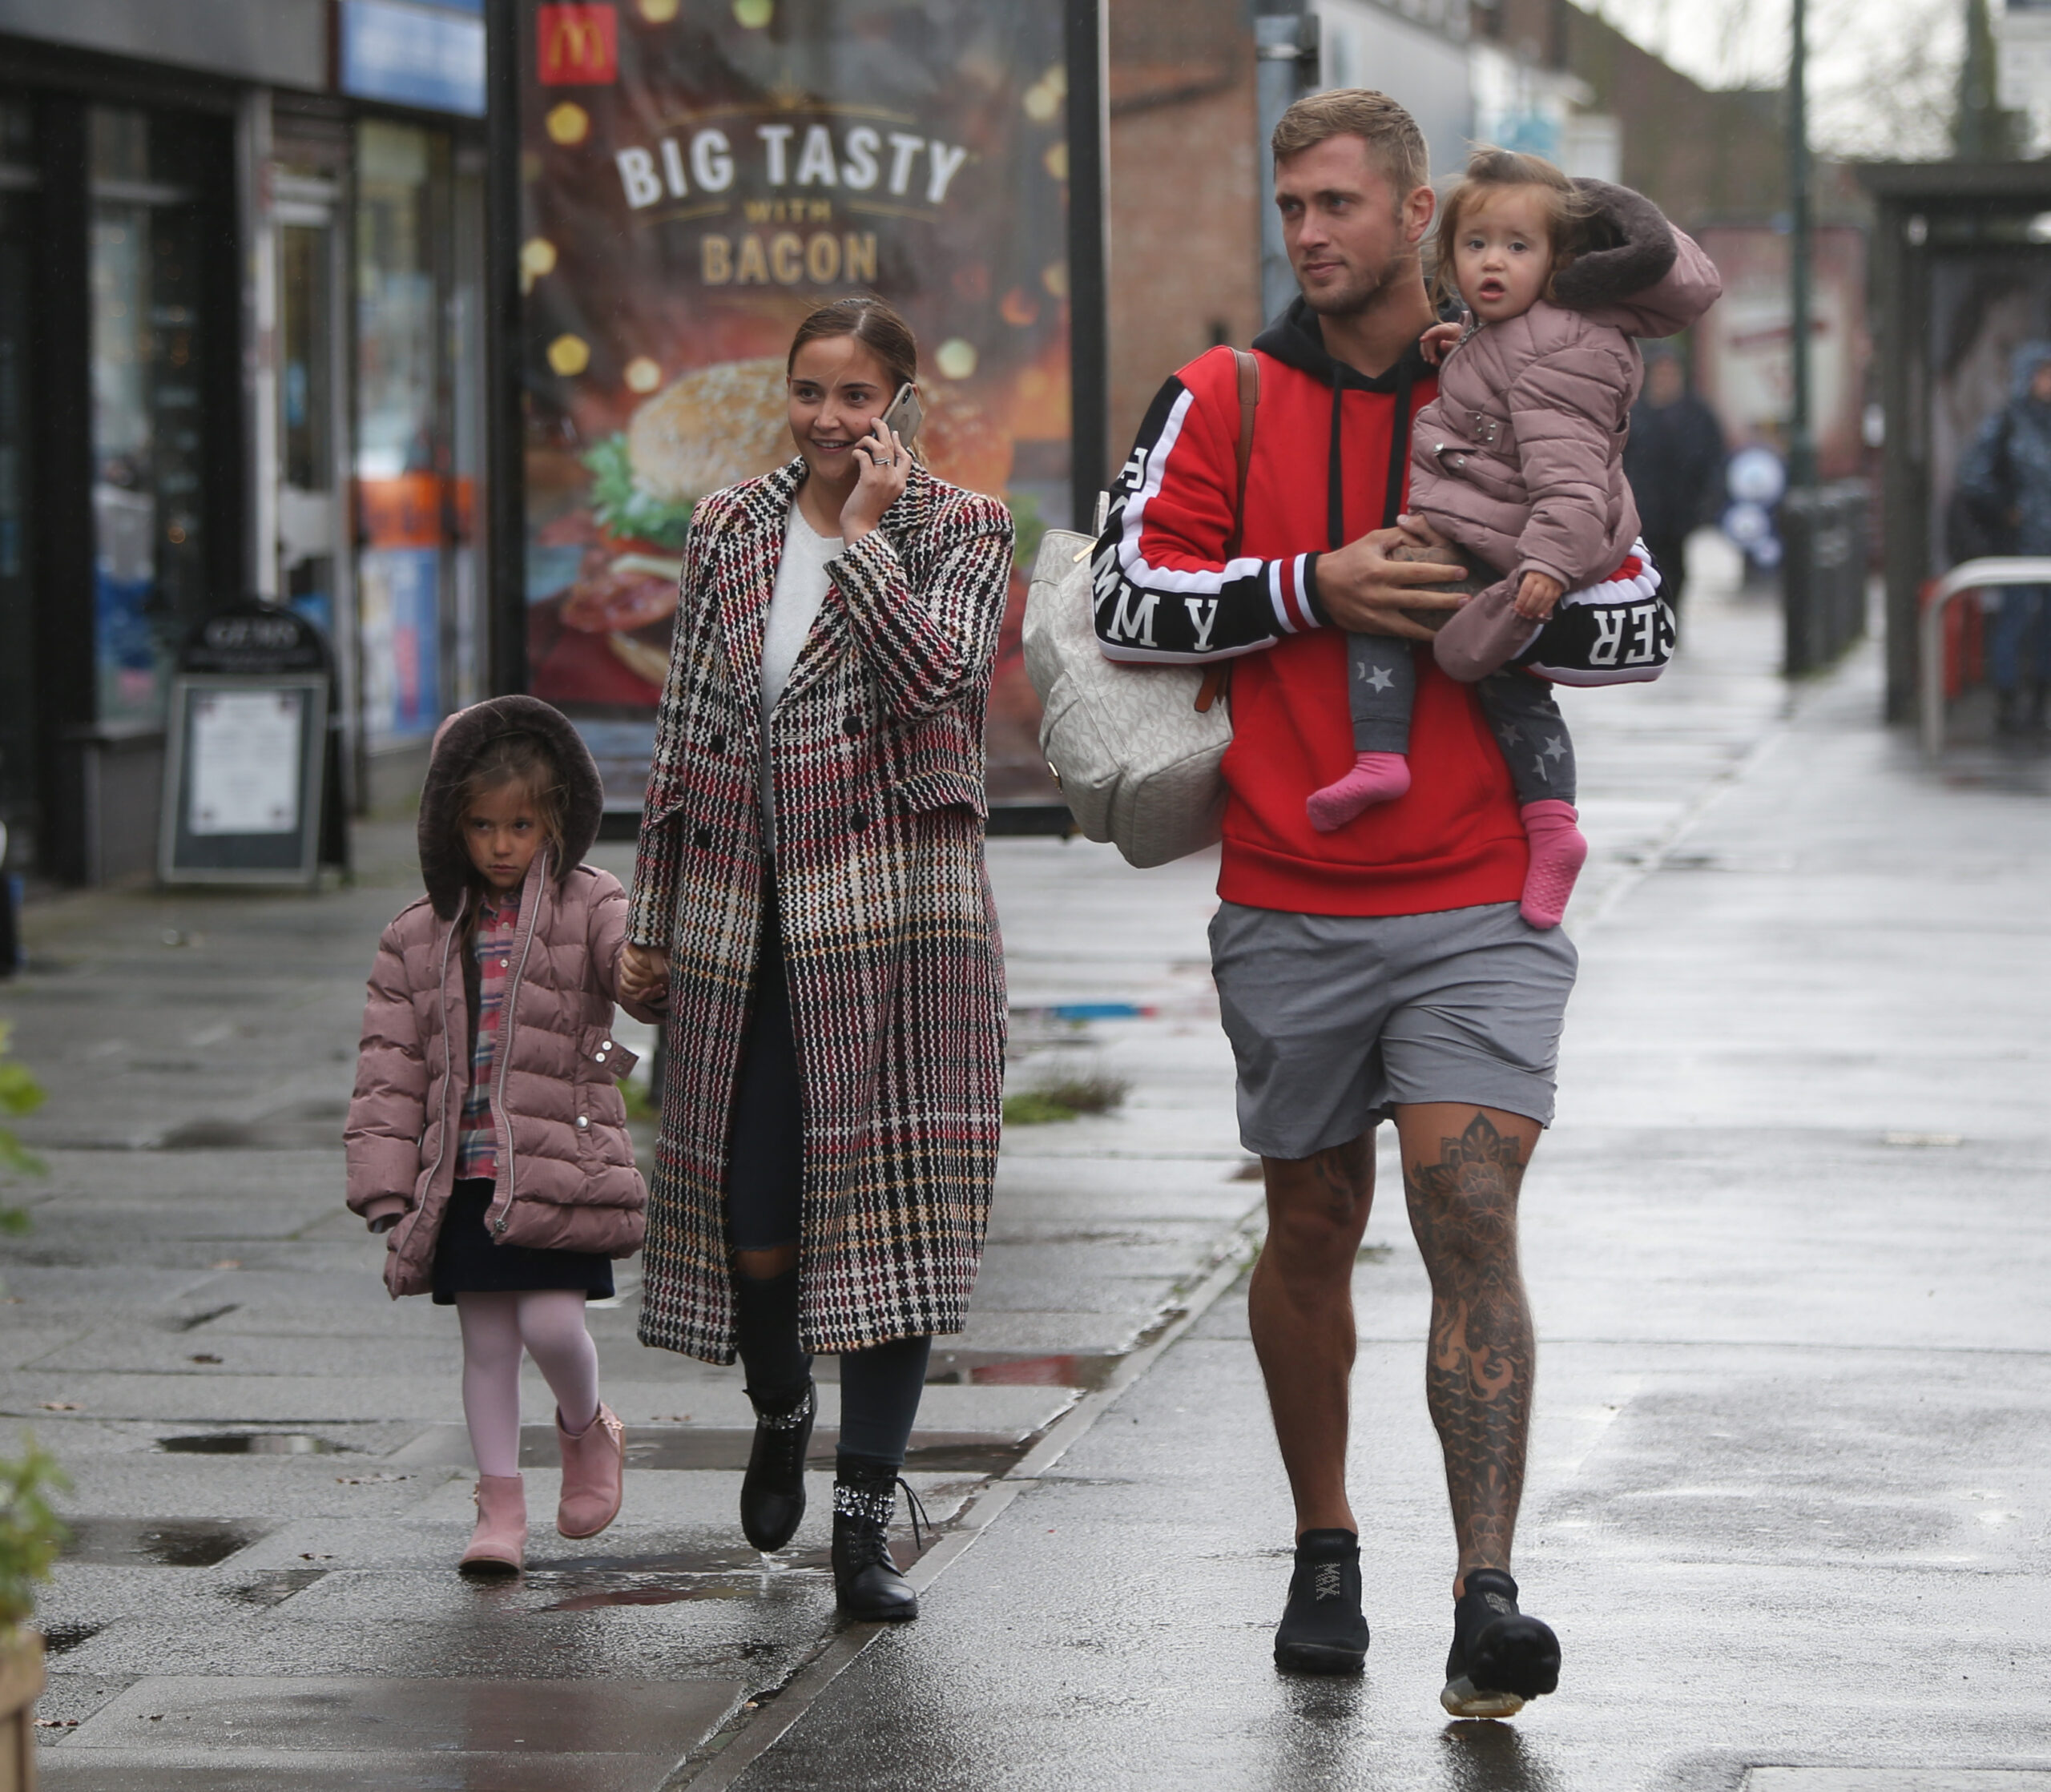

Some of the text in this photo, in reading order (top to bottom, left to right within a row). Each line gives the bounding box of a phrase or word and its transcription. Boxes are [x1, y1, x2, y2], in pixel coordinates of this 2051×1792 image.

[617, 123, 967, 210] BIG TASTY
[743, 199, 832, 224] WITH
[701, 232, 878, 286] BACON
